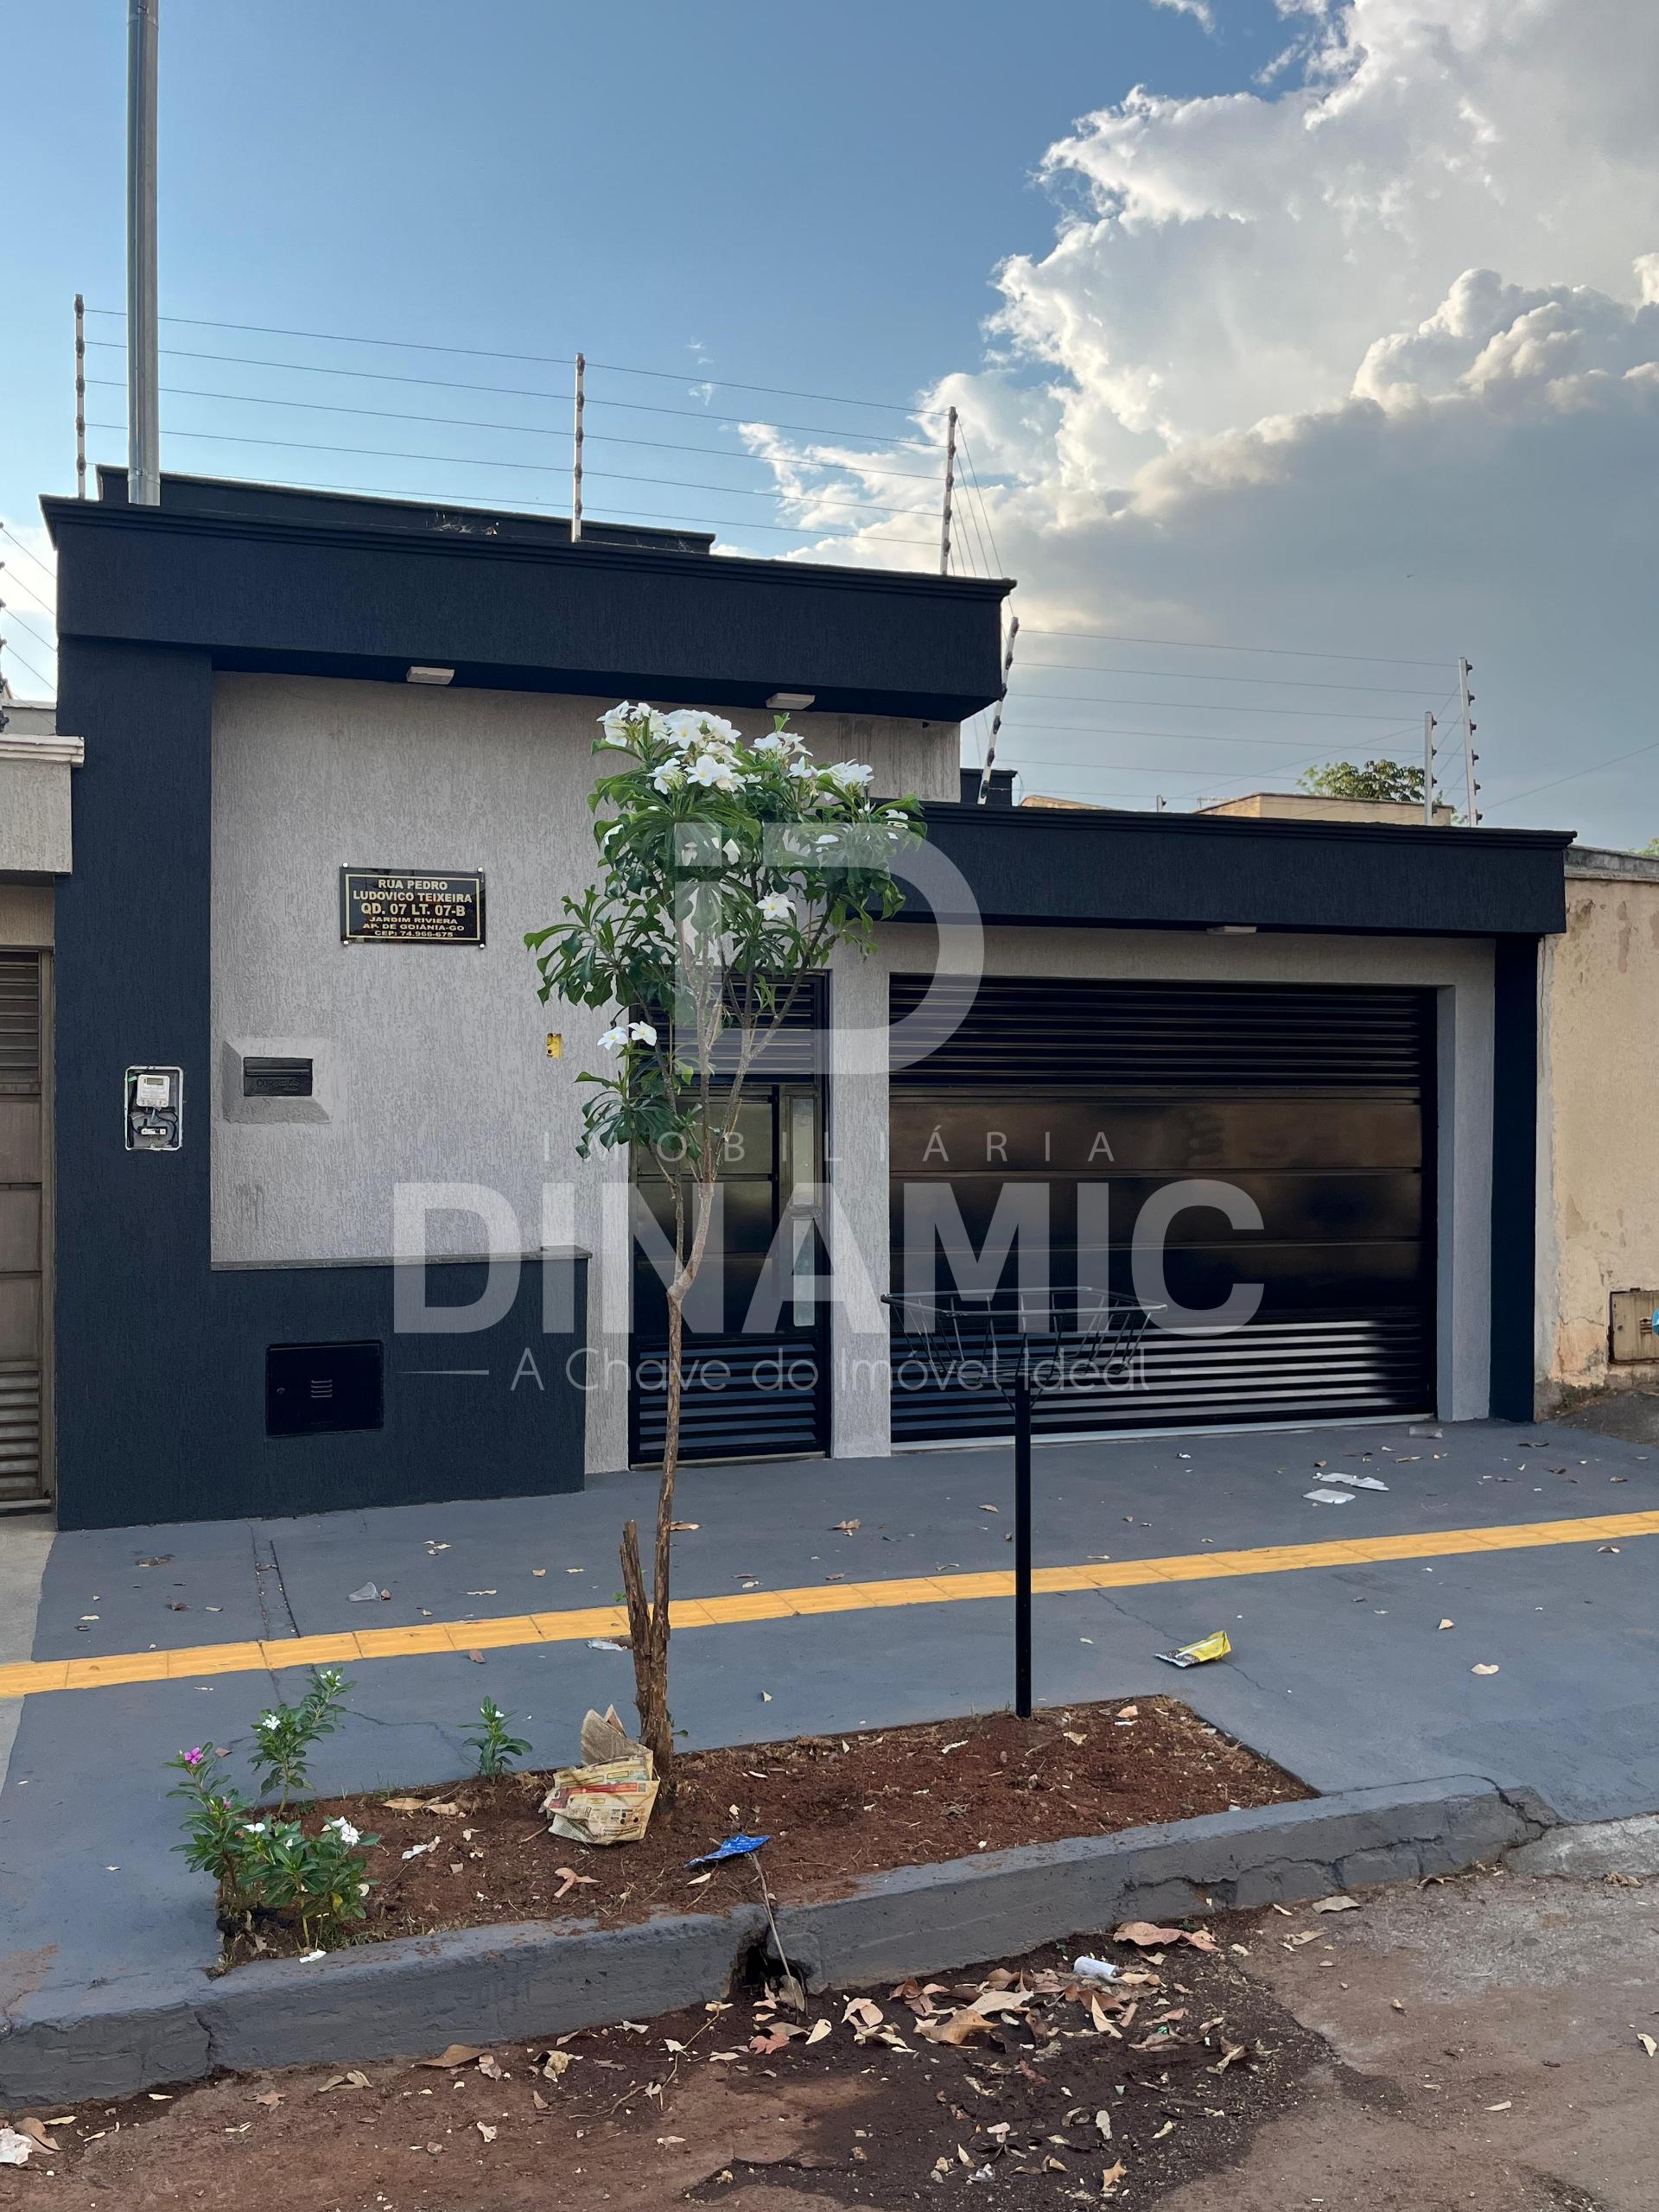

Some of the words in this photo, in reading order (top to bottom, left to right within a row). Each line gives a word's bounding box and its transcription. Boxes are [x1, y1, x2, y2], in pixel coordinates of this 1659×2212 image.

[378, 879, 404, 889] RUA
[407, 880, 448, 891] PEDRO
[353, 890, 415, 901] LUDOVICO
[417, 892, 473, 903] TEIXEIRA
[360, 902, 386, 915] QD.
[390, 903, 407, 915] 07
[411, 903, 430, 916] LT.
[435, 904, 466, 917] 07-B
